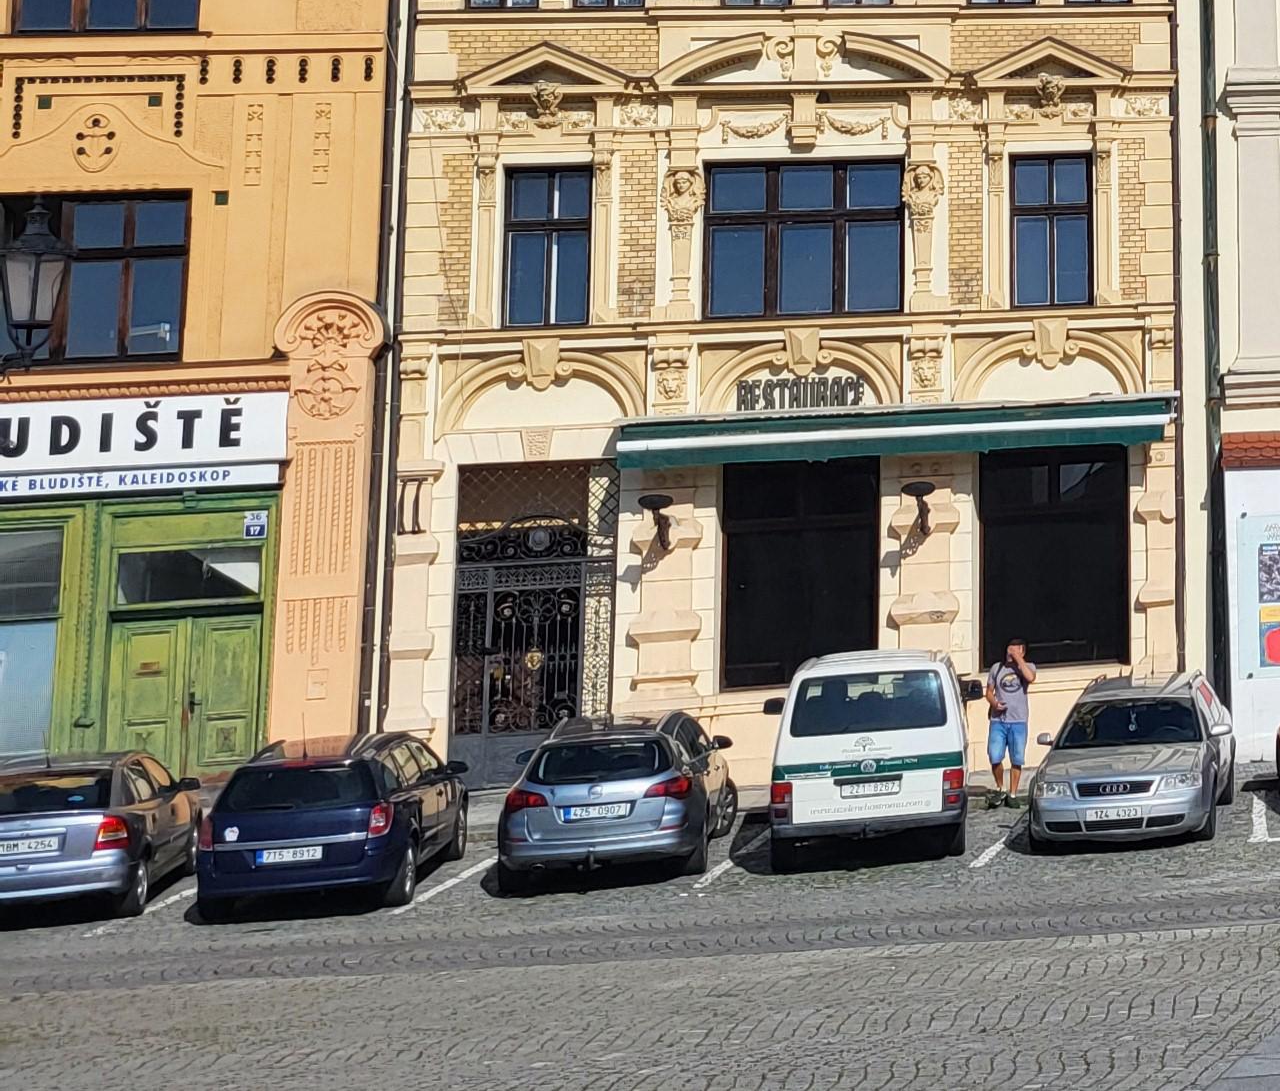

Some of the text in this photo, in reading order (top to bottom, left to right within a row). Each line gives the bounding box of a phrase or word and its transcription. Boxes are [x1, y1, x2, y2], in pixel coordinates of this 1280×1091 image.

[0, 397, 243, 458] UDIŠTĚ
[28, 472, 110, 491] BLUDIŠTĚ,
[118, 469, 231, 487] KALEIDOSKOP
[250, 512, 262, 521] 36
[249, 525, 261, 536] 17
[573, 805, 621, 817] 4Z5 0907
[265, 848, 317, 861] 7T5 8912
